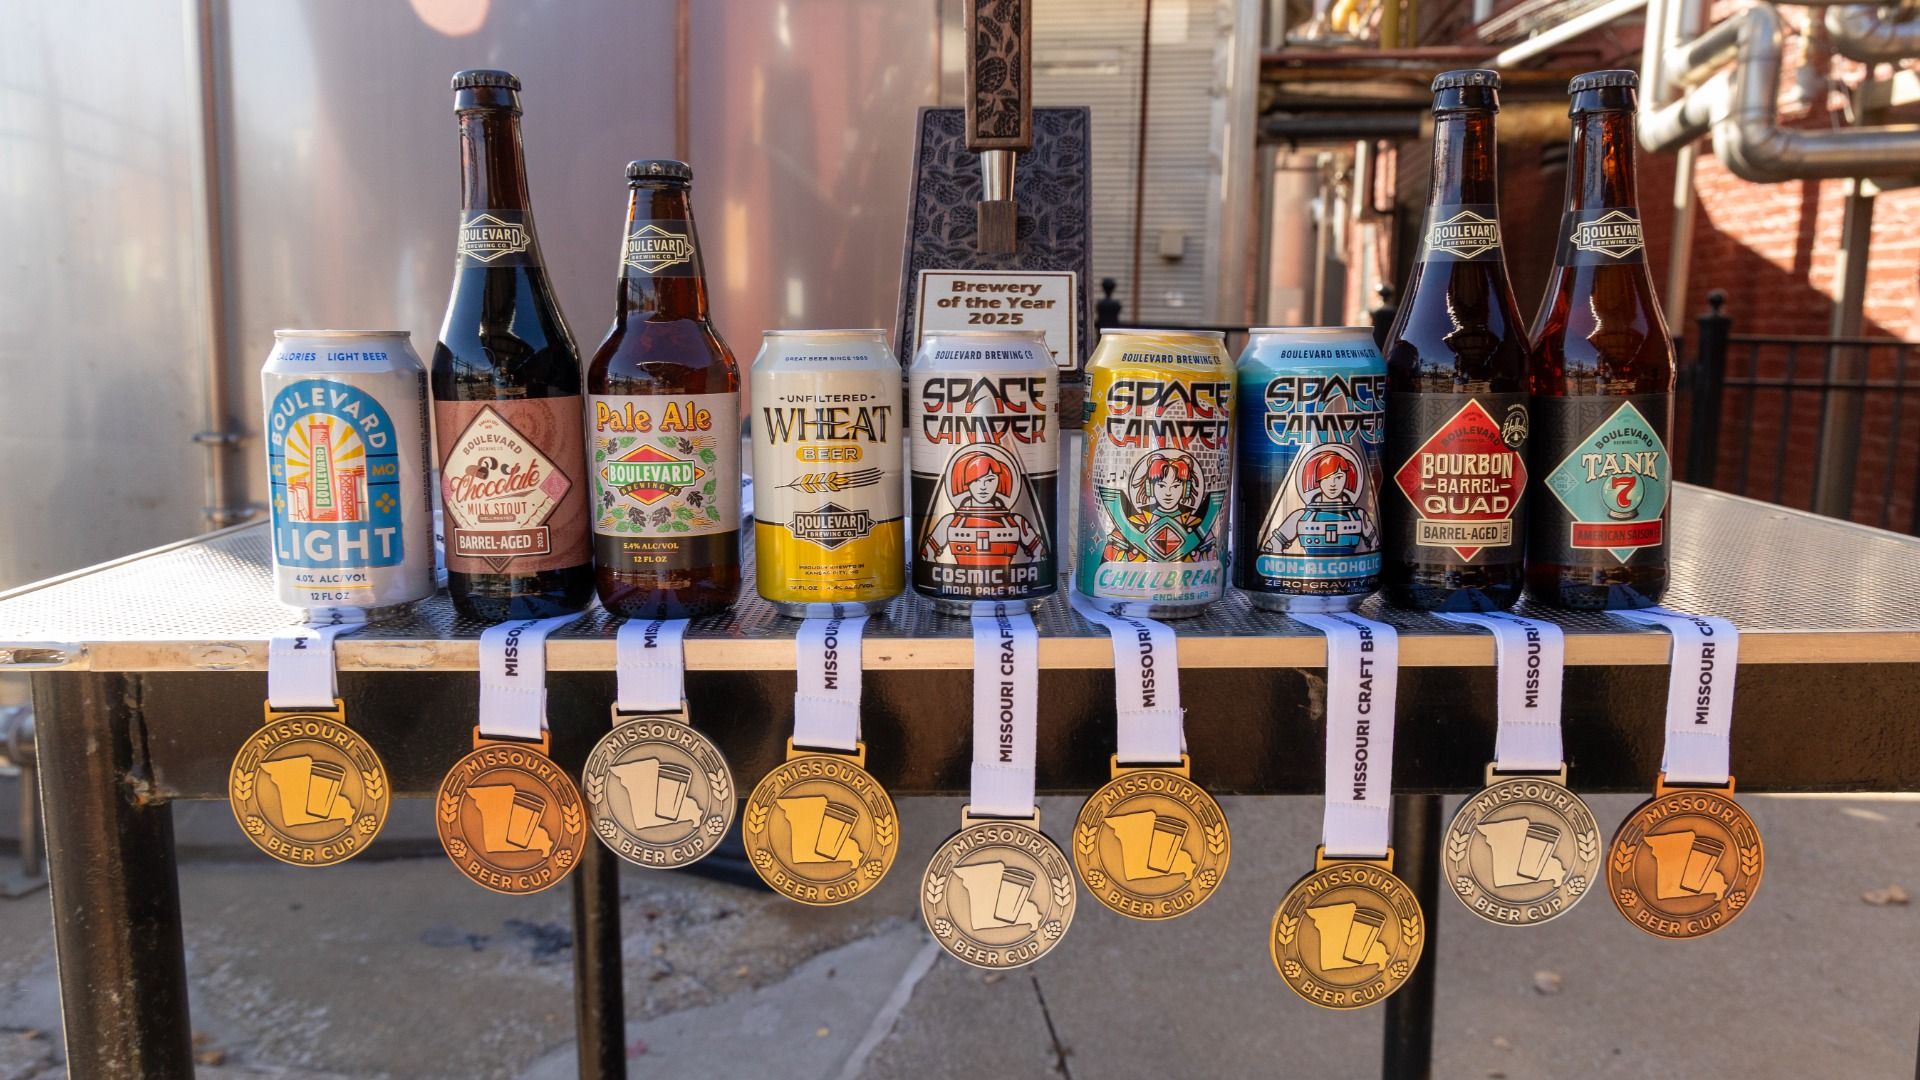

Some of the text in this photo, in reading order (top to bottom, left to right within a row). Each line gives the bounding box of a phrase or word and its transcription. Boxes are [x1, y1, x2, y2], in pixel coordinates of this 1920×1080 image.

[1434, 224, 1496, 245] BOULEVARD
[952, 281, 1042, 296] Brewery
[937, 296, 1056, 309] of the Year
[968, 313, 1024, 325] 2025
[327, 352, 359, 361] LIGHT
[362, 352, 388, 361] BEER
[935, 350, 982, 360] BOULEVARD
[985, 350, 1023, 360] BREWING
[1121, 353, 1173, 364] BOULEVARD
[1177, 355, 1212, 365] BREWING
[1280, 350, 1333, 359] BOULEVARD
[787, 394, 868, 403] UNFILTERED
[923, 377, 1047, 413] SPACE
[1107, 380, 1231, 418] SPACE
[1265, 375, 1386, 413] SPACE
[272, 388, 387, 448] BOULEVARD
[596, 401, 713, 433] Pale Ale
[763, 406, 892, 445] WHEAT
[1265, 413, 1385, 444] CAMPER
[923, 415, 1046, 444] CAMPER
[1107, 417, 1229, 449] CAMPER
[1441, 426, 1500, 447] BOULEVARD
[1595, 428, 1653, 449] BOULEVARD
[463, 434, 523, 456] BOULEVARD
[803, 448, 858, 460] BEER
[316, 448, 330, 505] BOULEVARD
[372, 463, 396, 476] MO
[610, 465, 692, 482] BOULEVARD
[1421, 453, 1513, 479] BOURBON
[1581, 452, 1659, 483] TANK
[451, 458, 541, 503] Chocolate
[621, 482, 665, 495] BREWING
[1438, 479, 1499, 493] BARREL
[1611, 476, 1636, 508] 7
[467, 501, 527, 515] MILK STOUT
[1424, 495, 1509, 514] QUAD
[796, 514, 865, 534] BOULEVARD
[1424, 526, 1498, 540] BARREL-AGED
[1578, 529, 1625, 541] AMERICAN
[278, 527, 396, 561] LIGHT
[459, 534, 532, 550] BARREL-AGED
[642, 542, 679, 550] ALC/VOL
[932, 567, 1038, 584] COSMIC IPA
[1265, 557, 1380, 575] NON-ALCOHOLIC
[942, 585, 1028, 596] INDIA PALE ALE
[1099, 567, 1221, 590] CHILLBREAK
[1265, 579, 1366, 589] ZERO-GRAVITY
[311, 592, 350, 600] 12 FL OZ
[1152, 592, 1195, 601] ENDLESS
[1137, 628, 1156, 707] MISSOURI
[1524, 628, 1541, 708] MISSOURI
[1358, 658, 1374, 715] CRAFT
[1695, 642, 1715, 725] MISSOURI
[1000, 681, 1014, 762] MISSOURI
[257, 723, 356, 750] MISSOURI
[606, 725, 700, 754] MISSOURI
[464, 751, 558, 783] MISSOURI
[1353, 720, 1370, 800] MISSOURI
[776, 763, 872, 795] MISSOURI
[1103, 778, 1200, 805] MISSOURI
[1476, 786, 1574, 813] MISSOURI
[1645, 799, 1740, 827] MISSOURI
[268, 837, 355, 861] BEER CUP
[619, 839, 704, 863] BEER CUP
[953, 830, 1048, 857] MISSOURI
[468, 862, 551, 888] BEER CUP
[773, 872, 859, 900] BEER CUP
[1306, 870, 1400, 897] MISSOURI
[1108, 891, 1195, 915] BEER CUP
[1474, 897, 1562, 921] BEER CUP
[1637, 910, 1722, 934] BEER CUP
[953, 940, 1040, 964] BEER CUP
[1301, 981, 1385, 1005] BEER CUP
